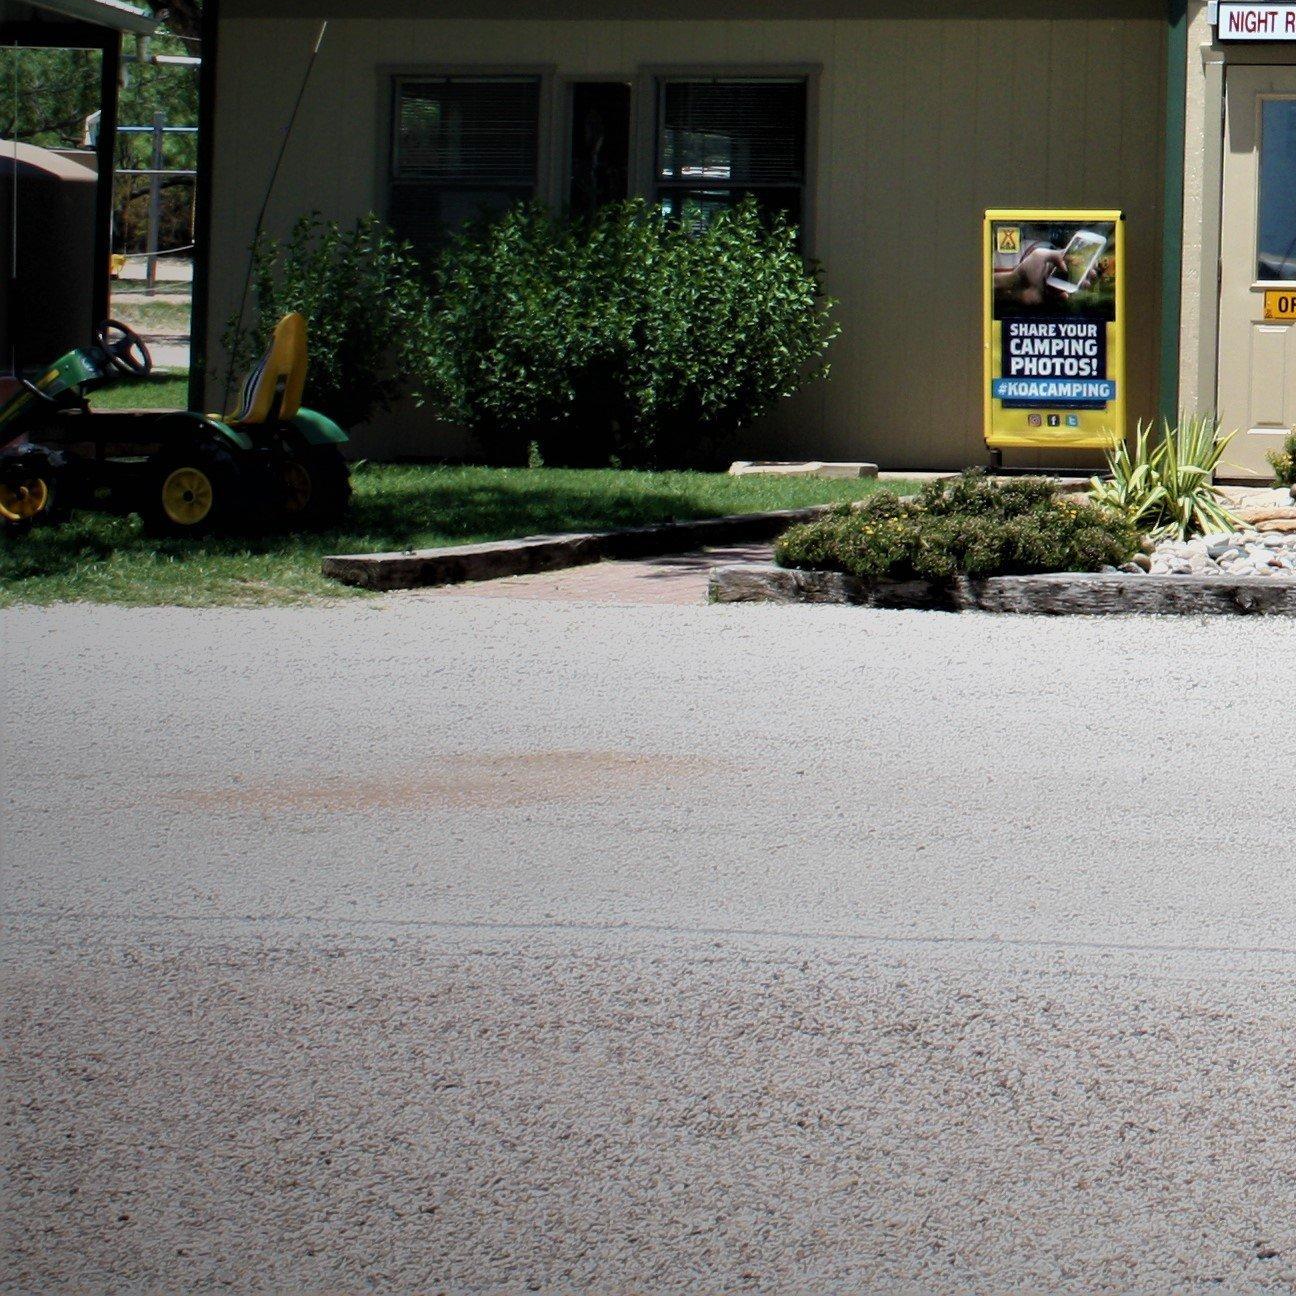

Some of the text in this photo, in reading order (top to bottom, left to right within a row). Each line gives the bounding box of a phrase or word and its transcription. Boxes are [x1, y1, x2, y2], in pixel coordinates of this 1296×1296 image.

[1228, 10, 1279, 33] NIGHT
[1010, 323, 1097, 337] SHARE YOUR
[1010, 338, 1098, 356] CAMPING
[1010, 357, 1098, 377] PHOTOS!
[998, 381, 1110, 398] #KOACAMPING
